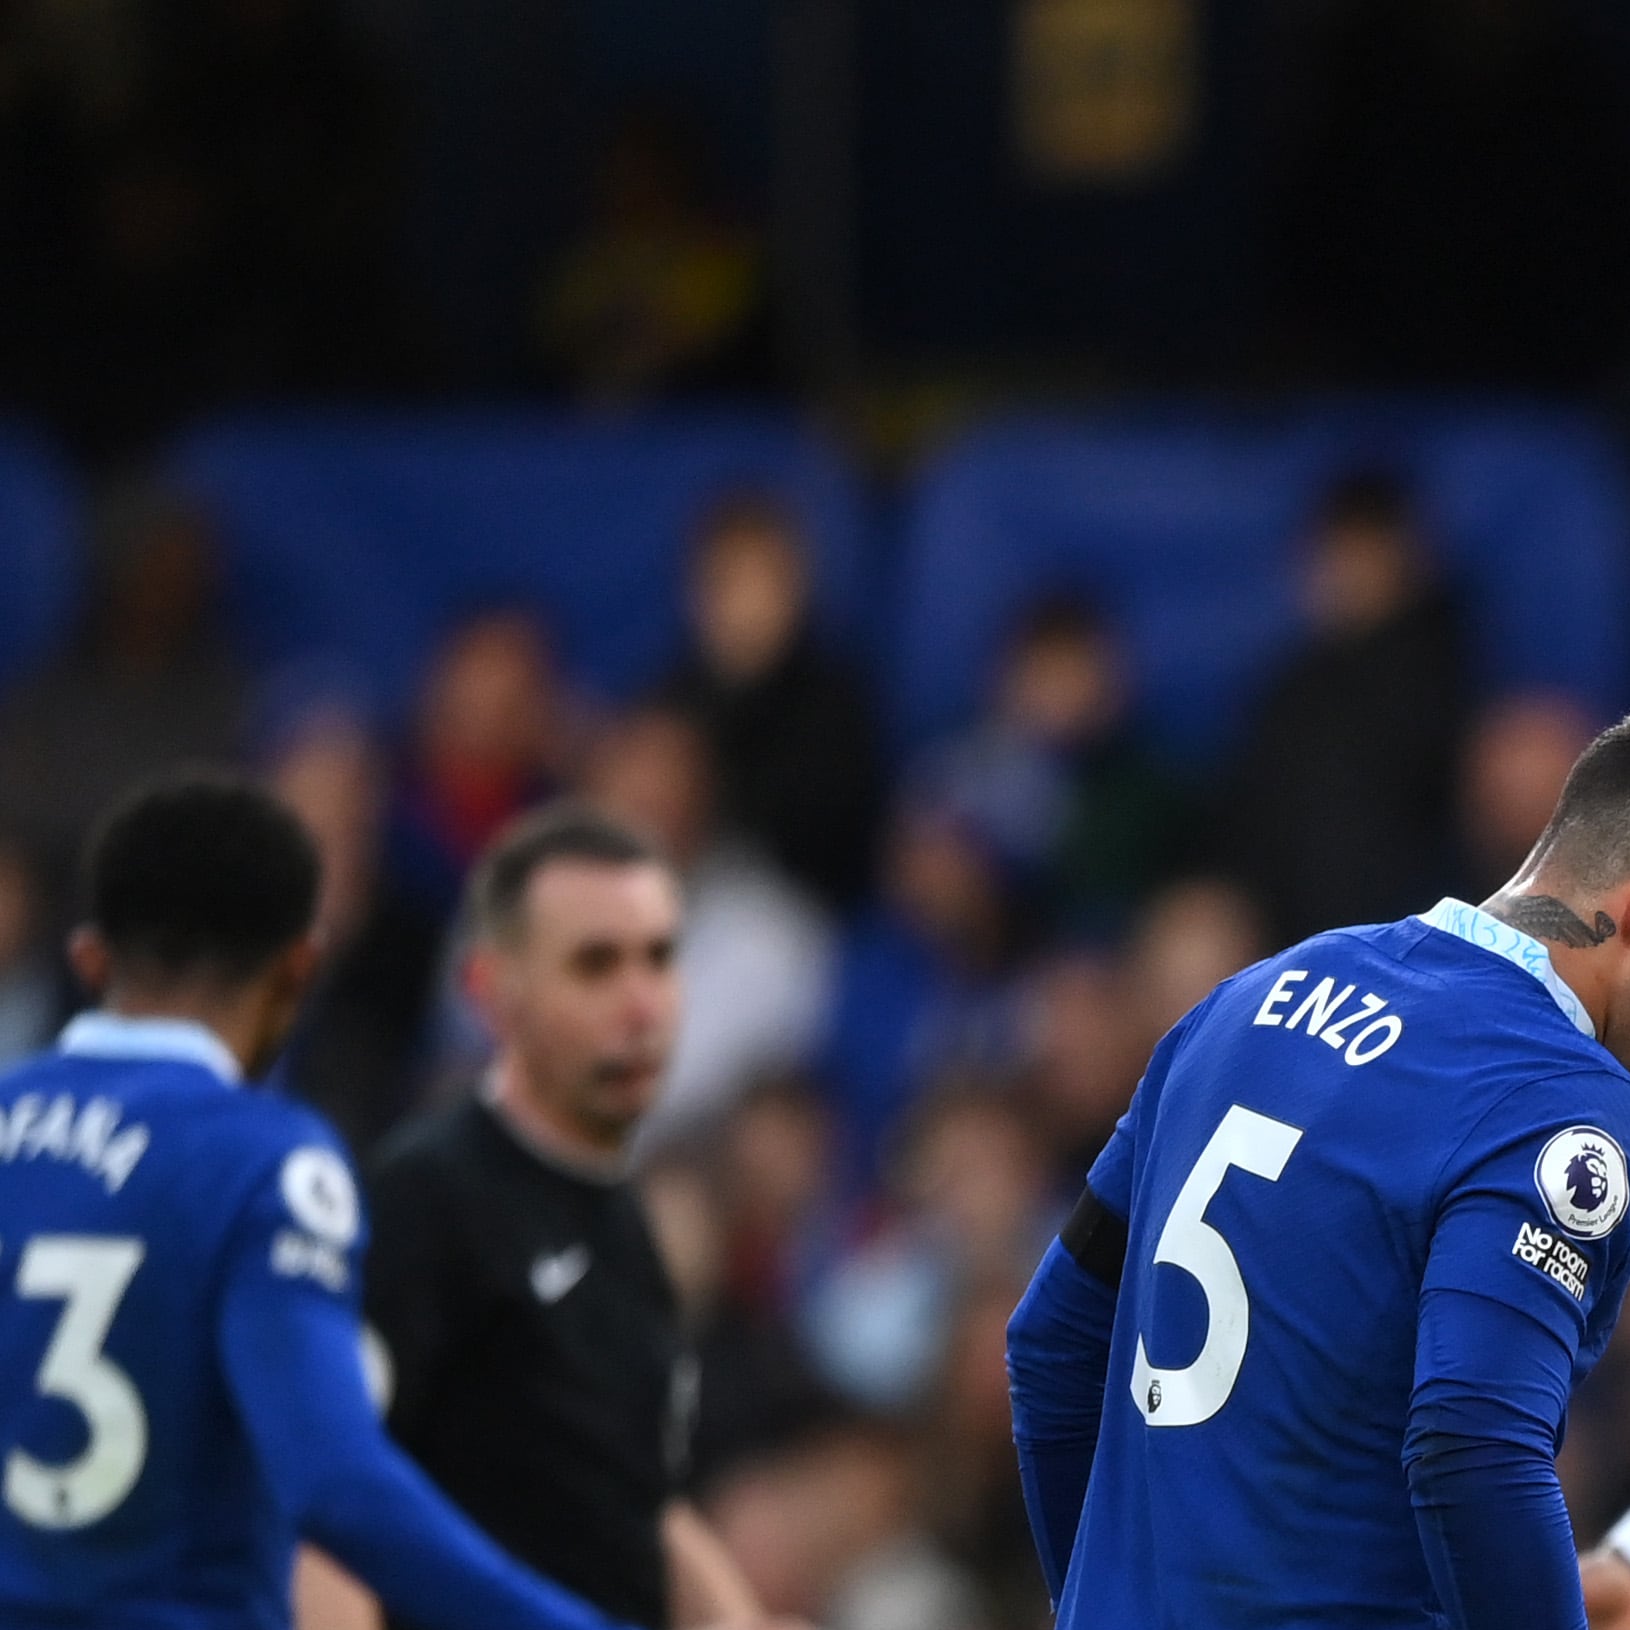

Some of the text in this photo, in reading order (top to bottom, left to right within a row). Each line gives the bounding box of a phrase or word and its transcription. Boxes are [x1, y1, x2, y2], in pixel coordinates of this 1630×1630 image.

[1252, 970, 1402, 1067] ENZO
[1567, 1213, 1600, 1227] Premier
[1130, 1103, 1304, 1427] 5
[1517, 1221, 1588, 1281] No room
[1543, 1256, 1586, 1302] racism
